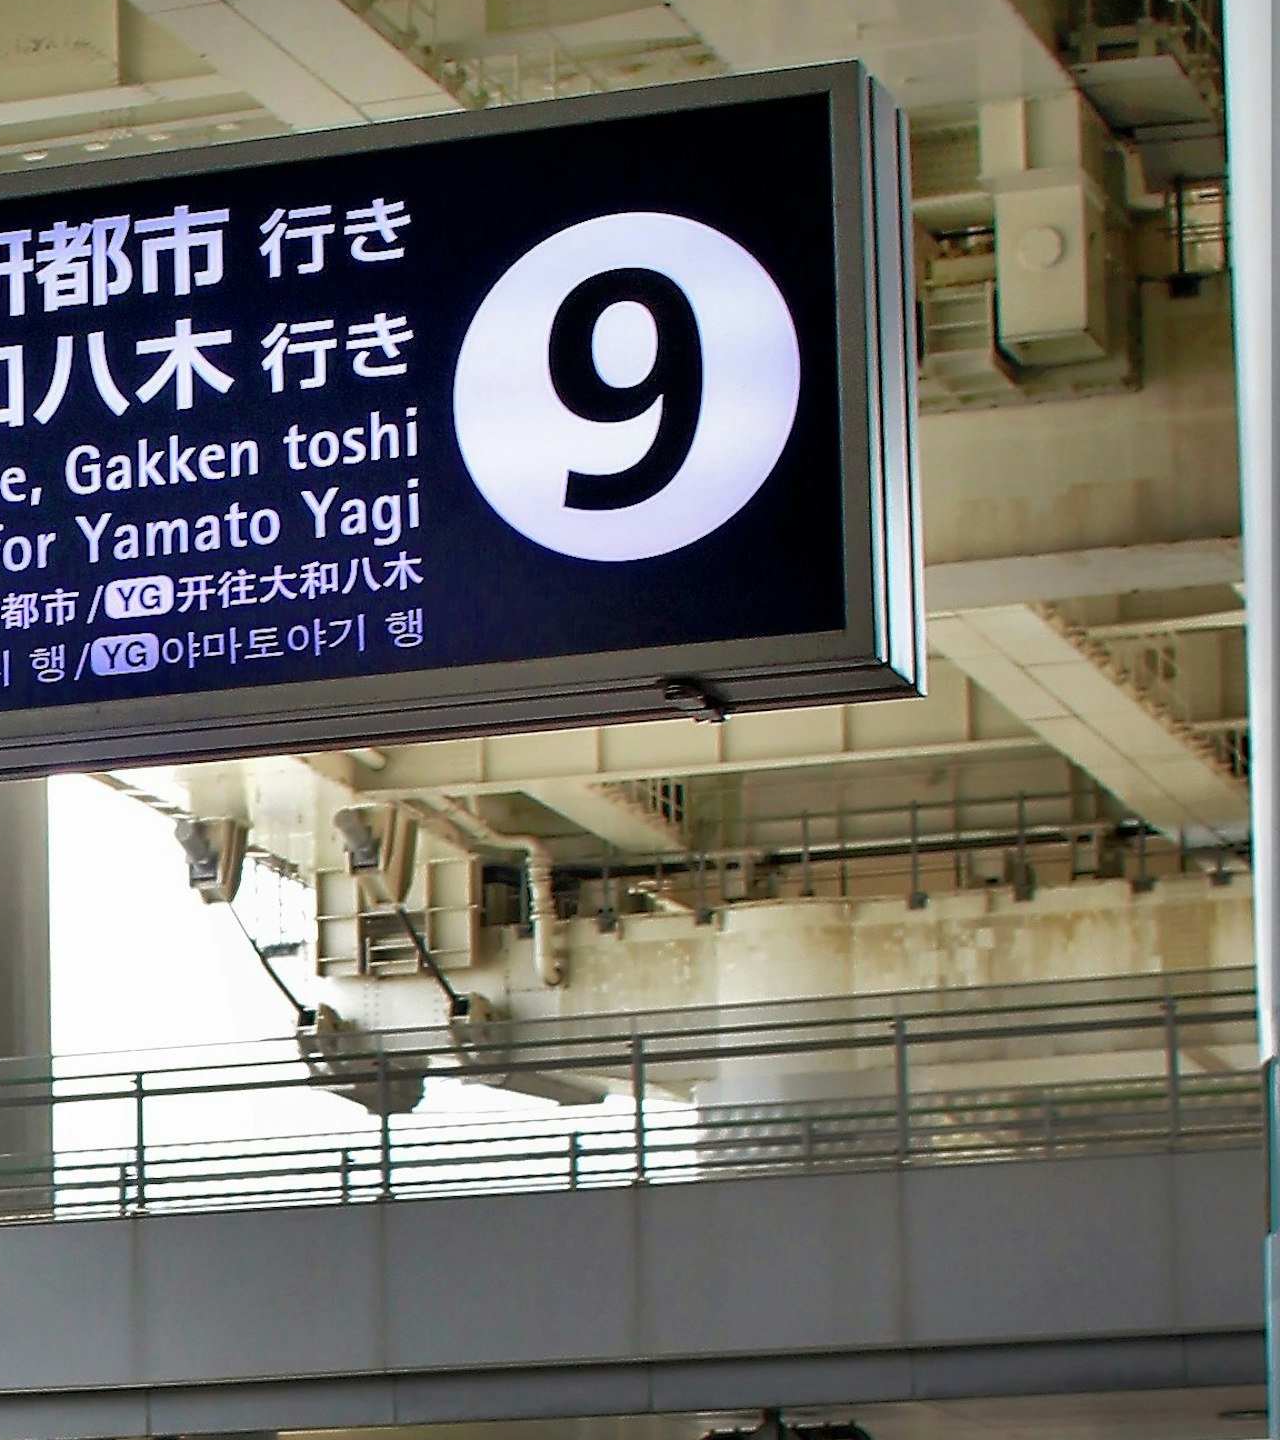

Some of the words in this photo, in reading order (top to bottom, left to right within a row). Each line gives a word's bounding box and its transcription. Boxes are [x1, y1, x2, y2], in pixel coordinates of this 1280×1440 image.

[259, 197, 412, 279] 行き
[260, 312, 415, 393] 行き
[547, 264, 706, 511] 9
[65, 434, 259, 495] Gakken
[282, 406, 420, 471] toshi
[74, 501, 281, 563] Yamato
[300, 478, 420, 547] Yagi
